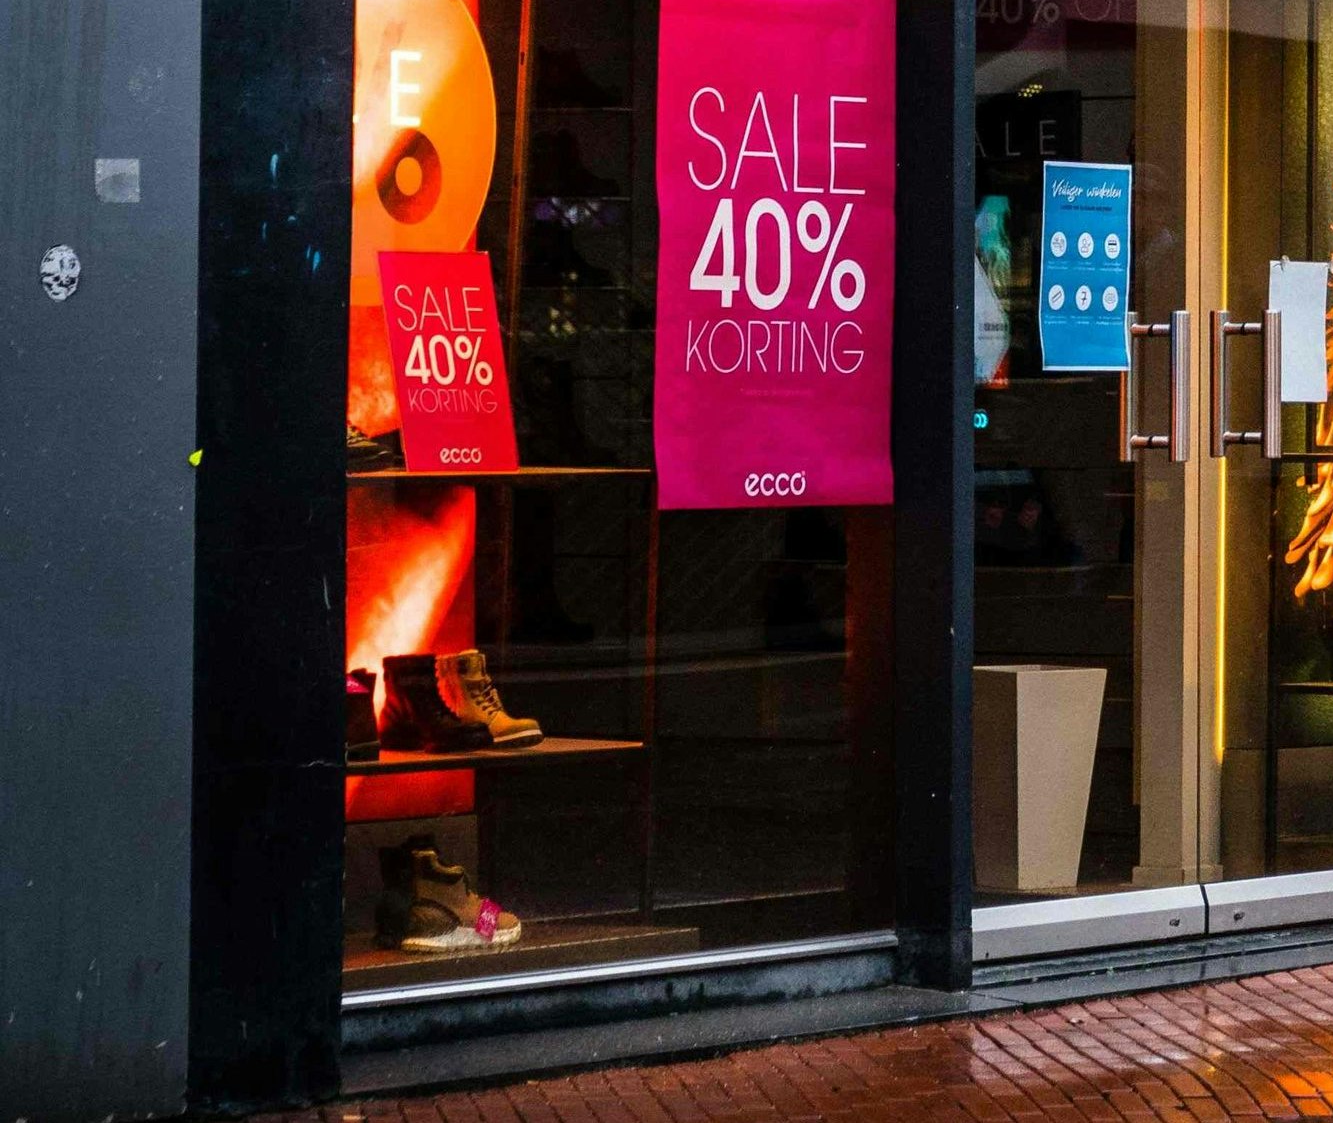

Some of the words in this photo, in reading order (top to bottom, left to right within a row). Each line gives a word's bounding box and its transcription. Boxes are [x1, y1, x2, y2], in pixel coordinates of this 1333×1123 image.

[688, 87, 867, 195] SALE
[690, 197, 867, 312] 40%
[394, 284, 487, 333] SALE
[405, 334, 494, 386] 40%
[686, 319, 865, 374] KORTING
[407, 387, 498, 414] KORTING
